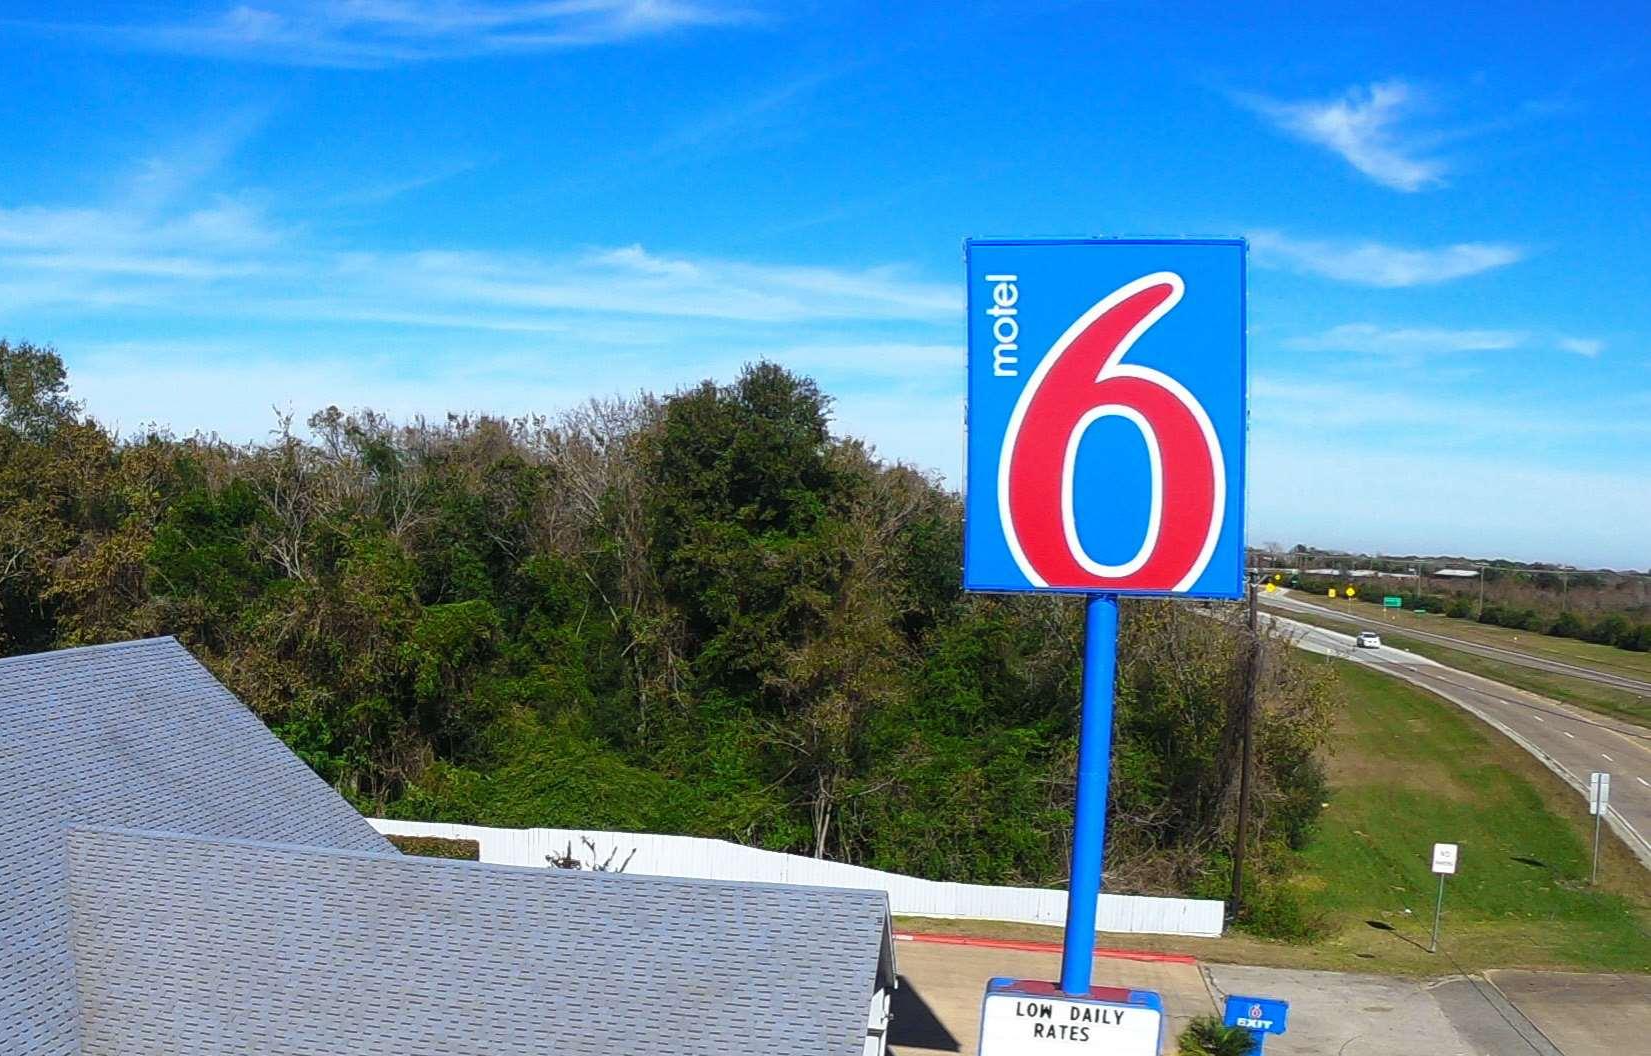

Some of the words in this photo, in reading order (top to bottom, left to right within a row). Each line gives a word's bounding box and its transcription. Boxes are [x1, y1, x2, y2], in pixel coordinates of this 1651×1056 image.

[985, 274, 1019, 377] motel
[997, 271, 1226, 592] 6
[1016, 1001, 1053, 1019] LOW
[1070, 1006, 1124, 1025] DAILY
[1237, 1017, 1273, 1029] EXIT
[1033, 1023, 1090, 1042] RATES
